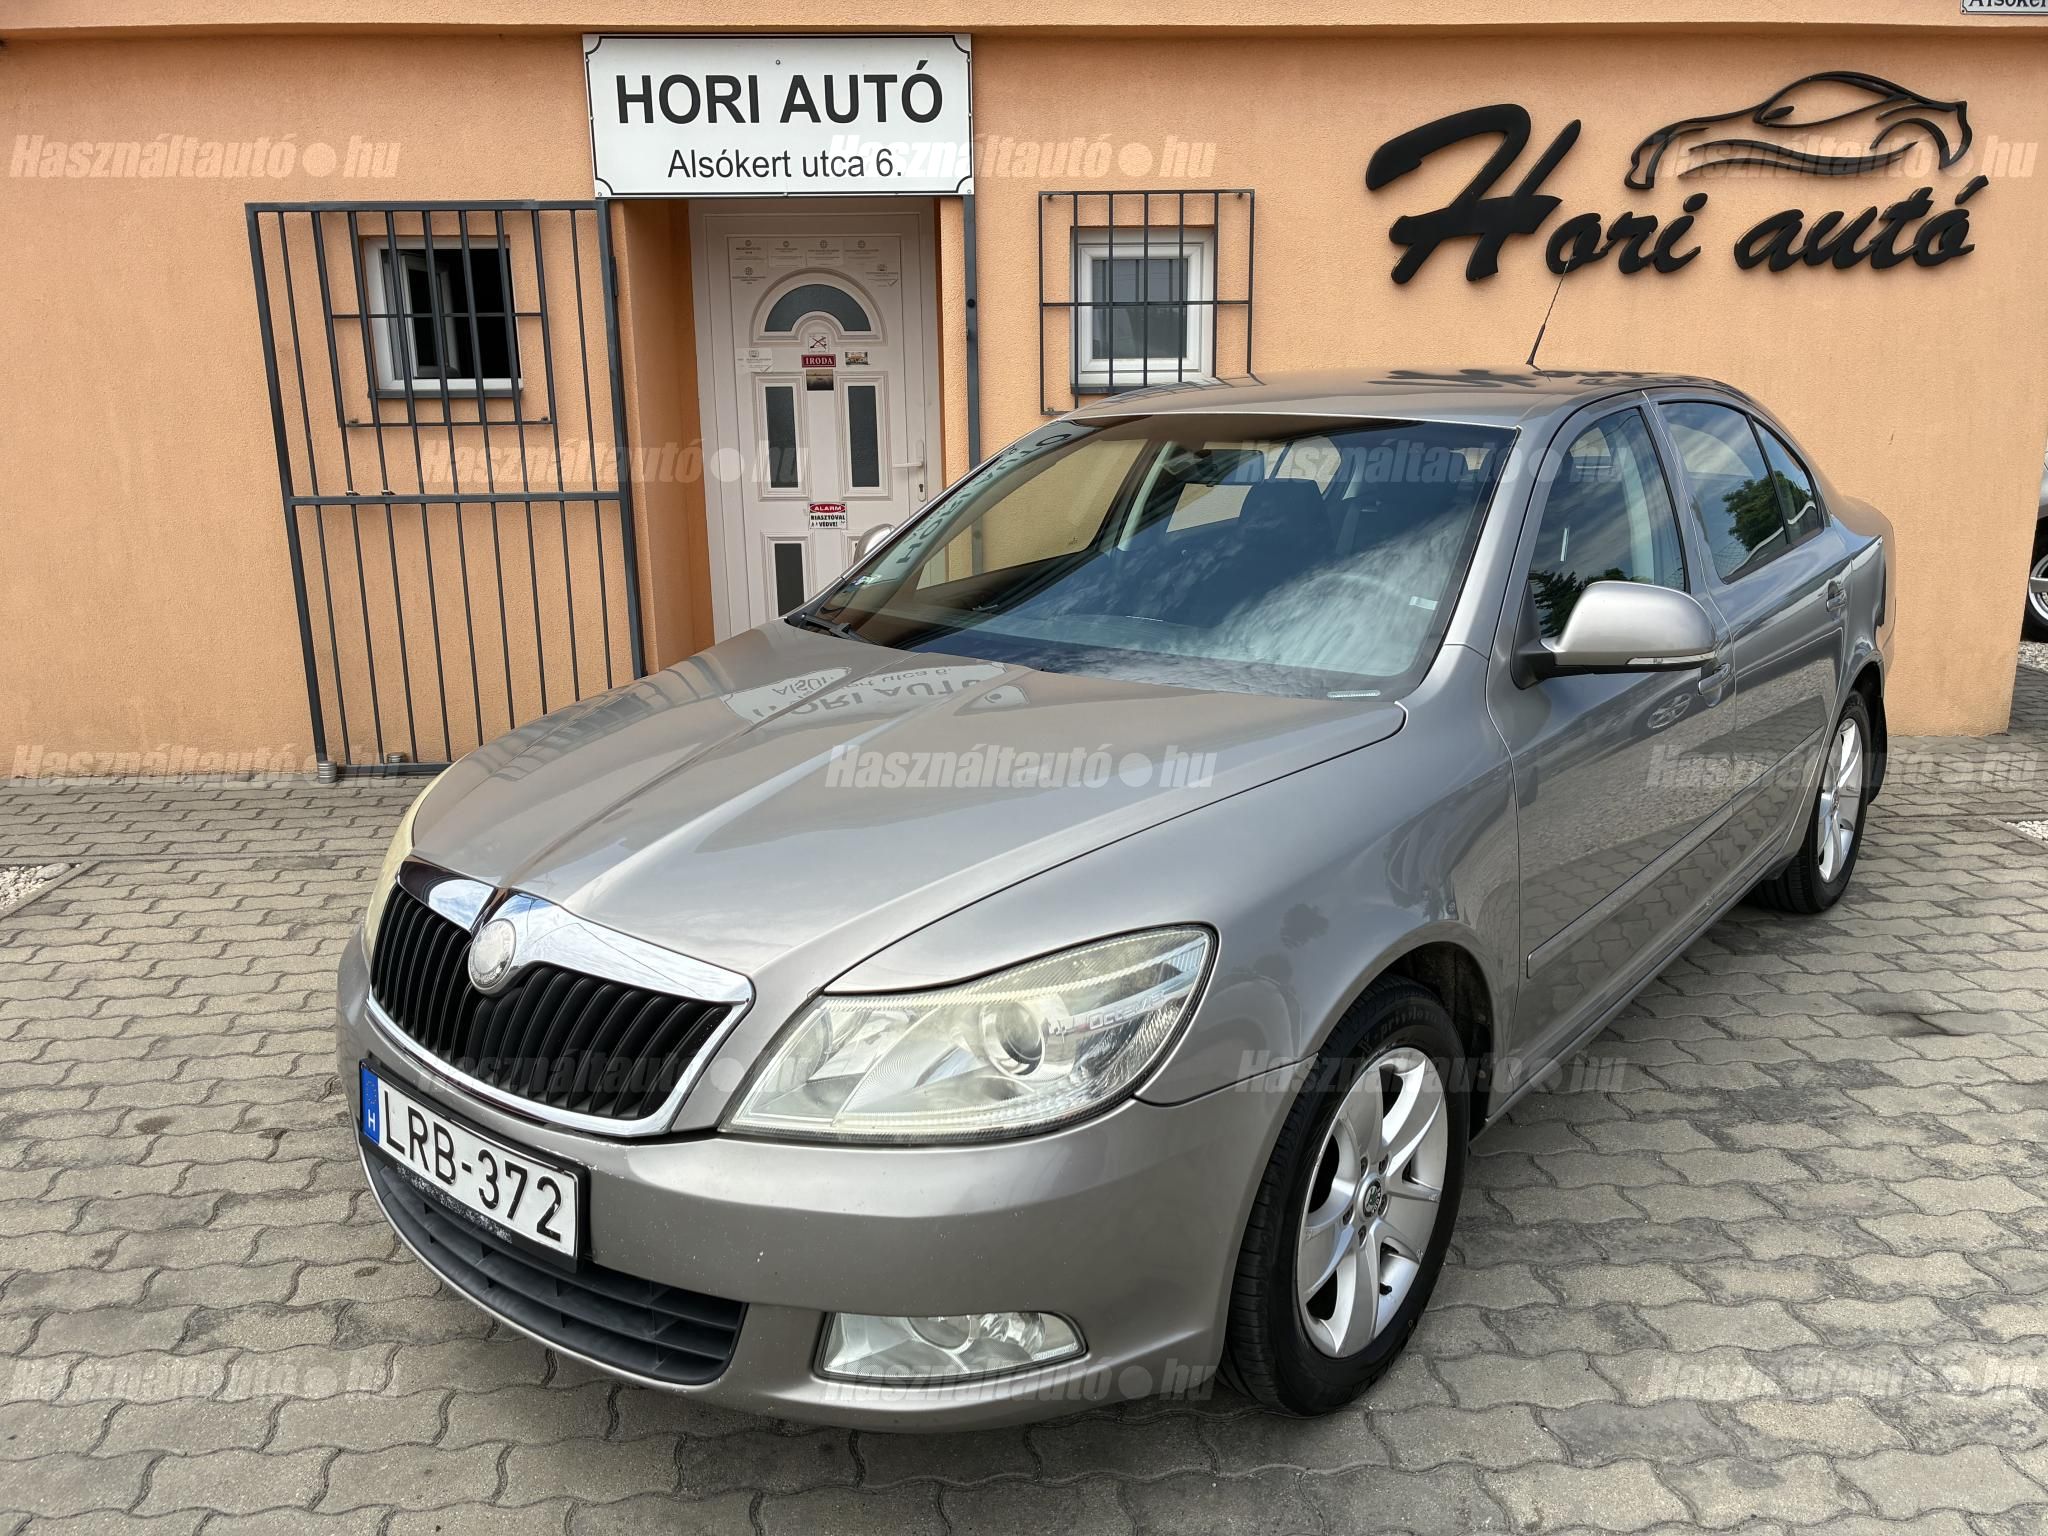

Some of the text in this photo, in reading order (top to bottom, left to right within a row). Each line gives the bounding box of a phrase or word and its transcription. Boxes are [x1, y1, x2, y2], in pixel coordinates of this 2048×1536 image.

[615, 59, 943, 125] HORI AUTÓ
[668, 147, 902, 179] Alsókert utca 6.
[1365, 102, 1990, 286] Hori autó
[804, 356, 834, 366] IRODA
[367, 1108, 377, 1133] H
[383, 1090, 563, 1243] LRB-372
